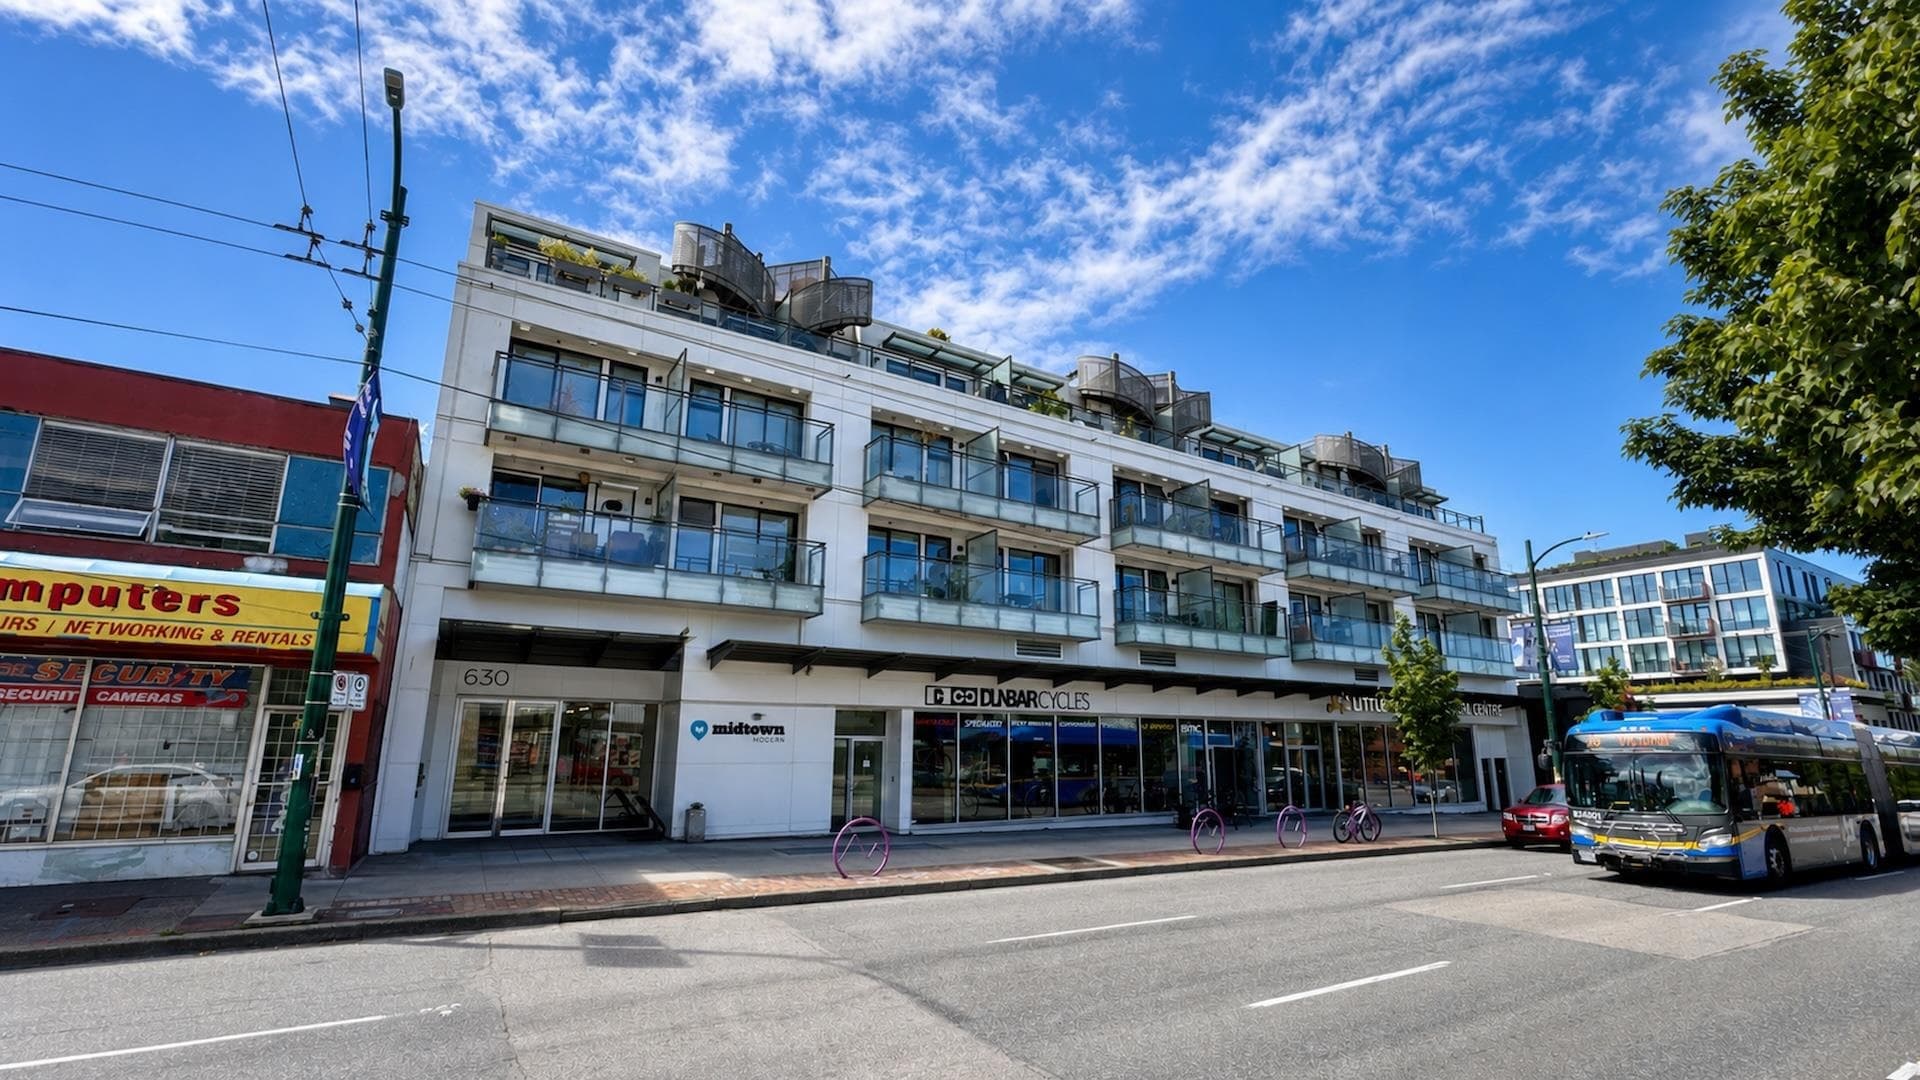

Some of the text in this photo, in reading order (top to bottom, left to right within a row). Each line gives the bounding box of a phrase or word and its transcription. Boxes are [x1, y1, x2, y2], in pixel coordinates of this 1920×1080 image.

[64, 620, 205, 641] NETWORKING
[210, 629, 225, 641] &
[231, 630, 313, 646] RENTALS
[32, 661, 235, 687] SECURITY
[464, 668, 510, 687] 630
[0, 688, 184, 704] SECURIT CAMERAS
[1472, 702, 1503, 717] CENTRE
[711, 721, 786, 736] midtown
